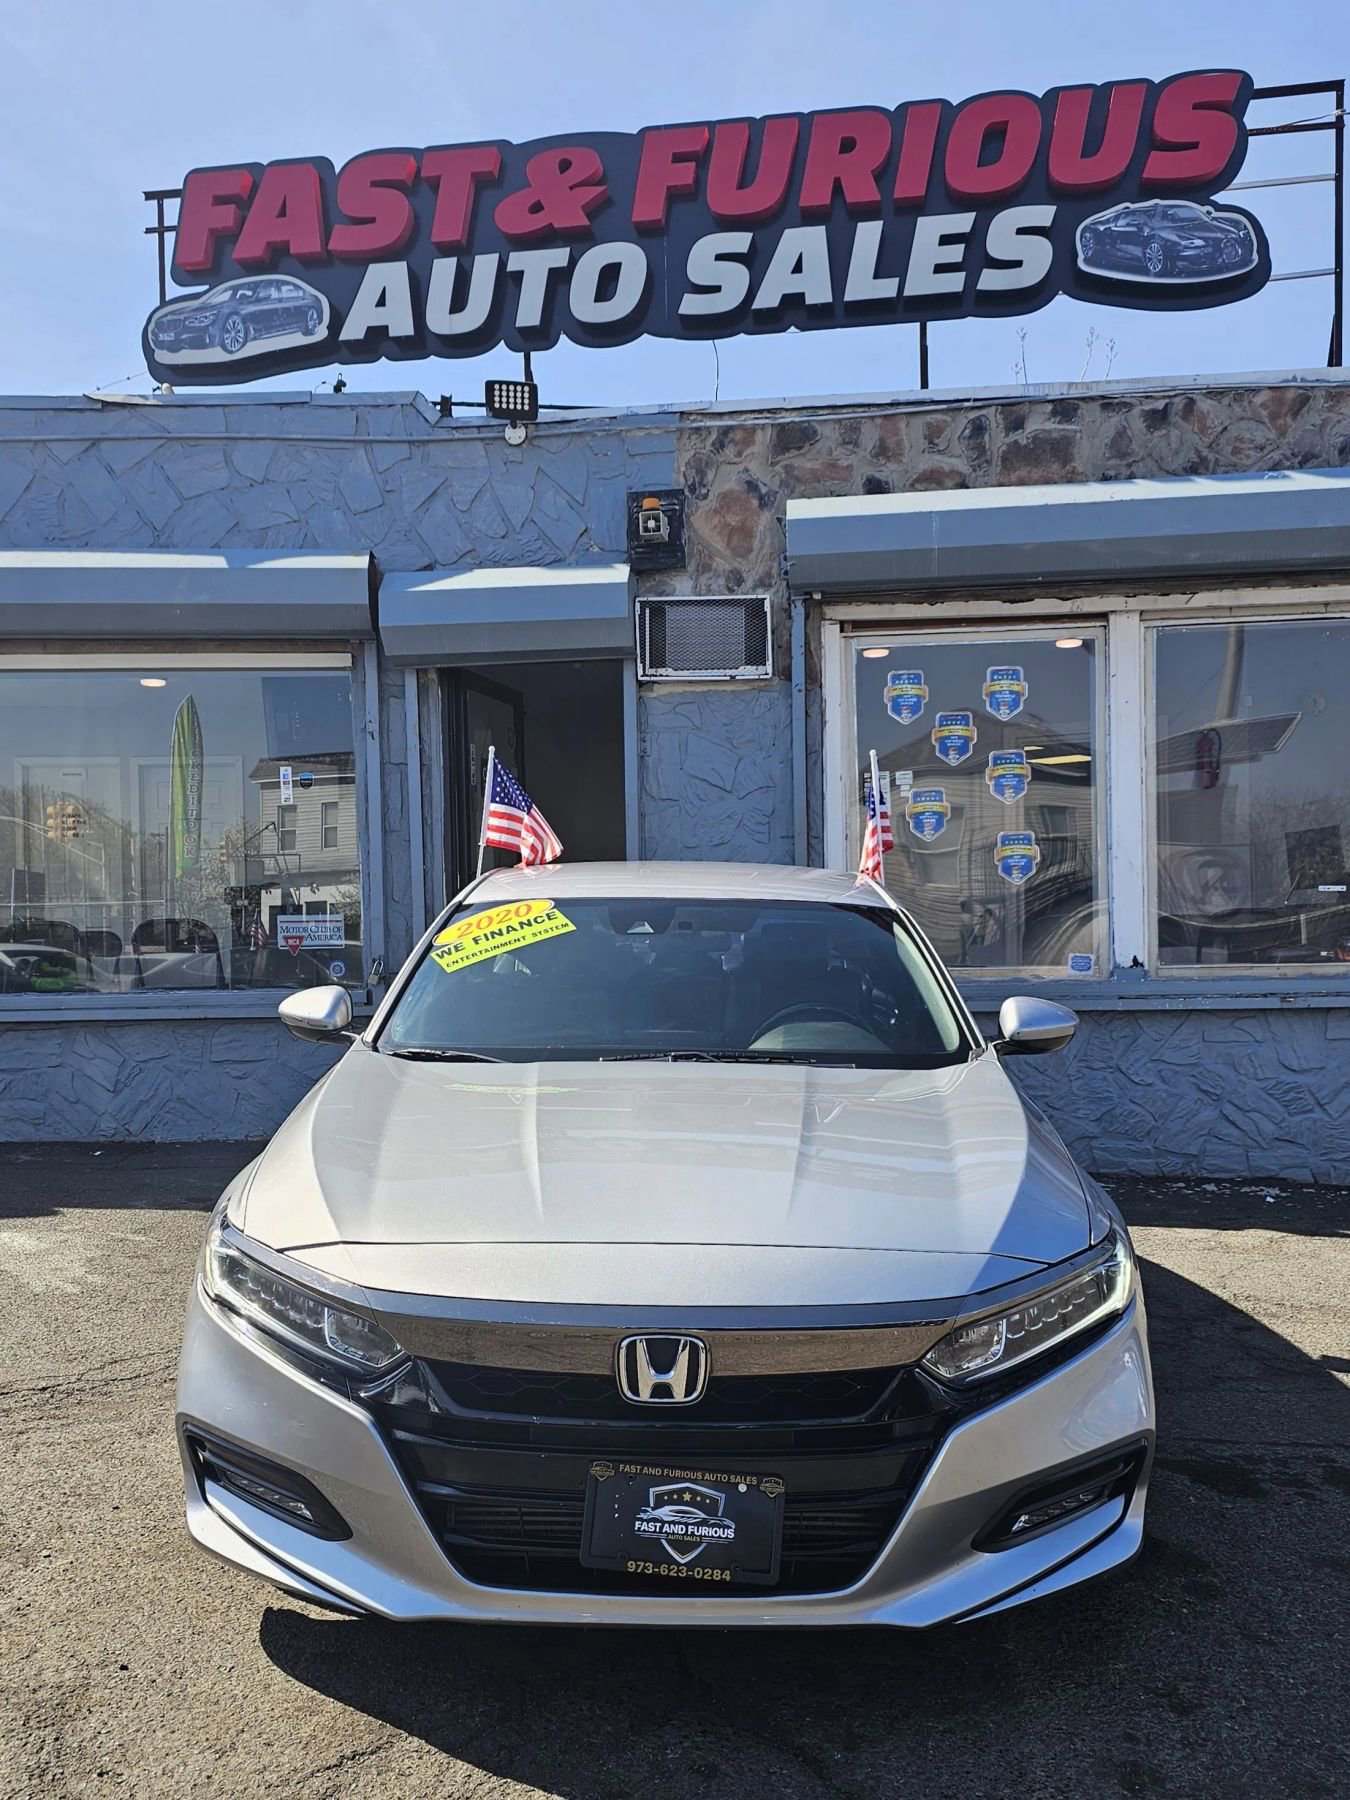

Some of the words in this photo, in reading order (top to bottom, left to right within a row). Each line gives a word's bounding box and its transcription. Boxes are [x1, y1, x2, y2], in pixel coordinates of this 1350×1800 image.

[175, 146, 502, 272] FAST
[494, 146, 608, 239] &
[631, 71, 1247, 229] FURIOUS
[338, 241, 648, 341] AUTO
[677, 204, 1057, 316] SALES
[280, 925, 309, 934] MOTOR
[309, 924, 331, 934] CLUB
[332, 925, 343, 934] OF
[435, 942, 466, 960] WE
[472, 911, 558, 946] FINANCE
[457, 903, 533, 939] 2020
[305, 933, 343, 941] AMERICA
[446, 935, 527, 968] ENTERTAINMENT
[531, 922, 570, 938] SYSTEM
[619, 1464, 641, 1474] FAST
[642, 1466, 662, 1476] AND
[663, 1469, 703, 1480] FURIOUS
[703, 1472, 728, 1482] AUTO
[729, 1474, 758, 1485] SALES
[634, 1521, 661, 1533] FAST
[662, 1523, 686, 1535] AND
[687, 1525, 735, 1539] FURIOUS
[626, 1560, 732, 1582] 973-623-0284
